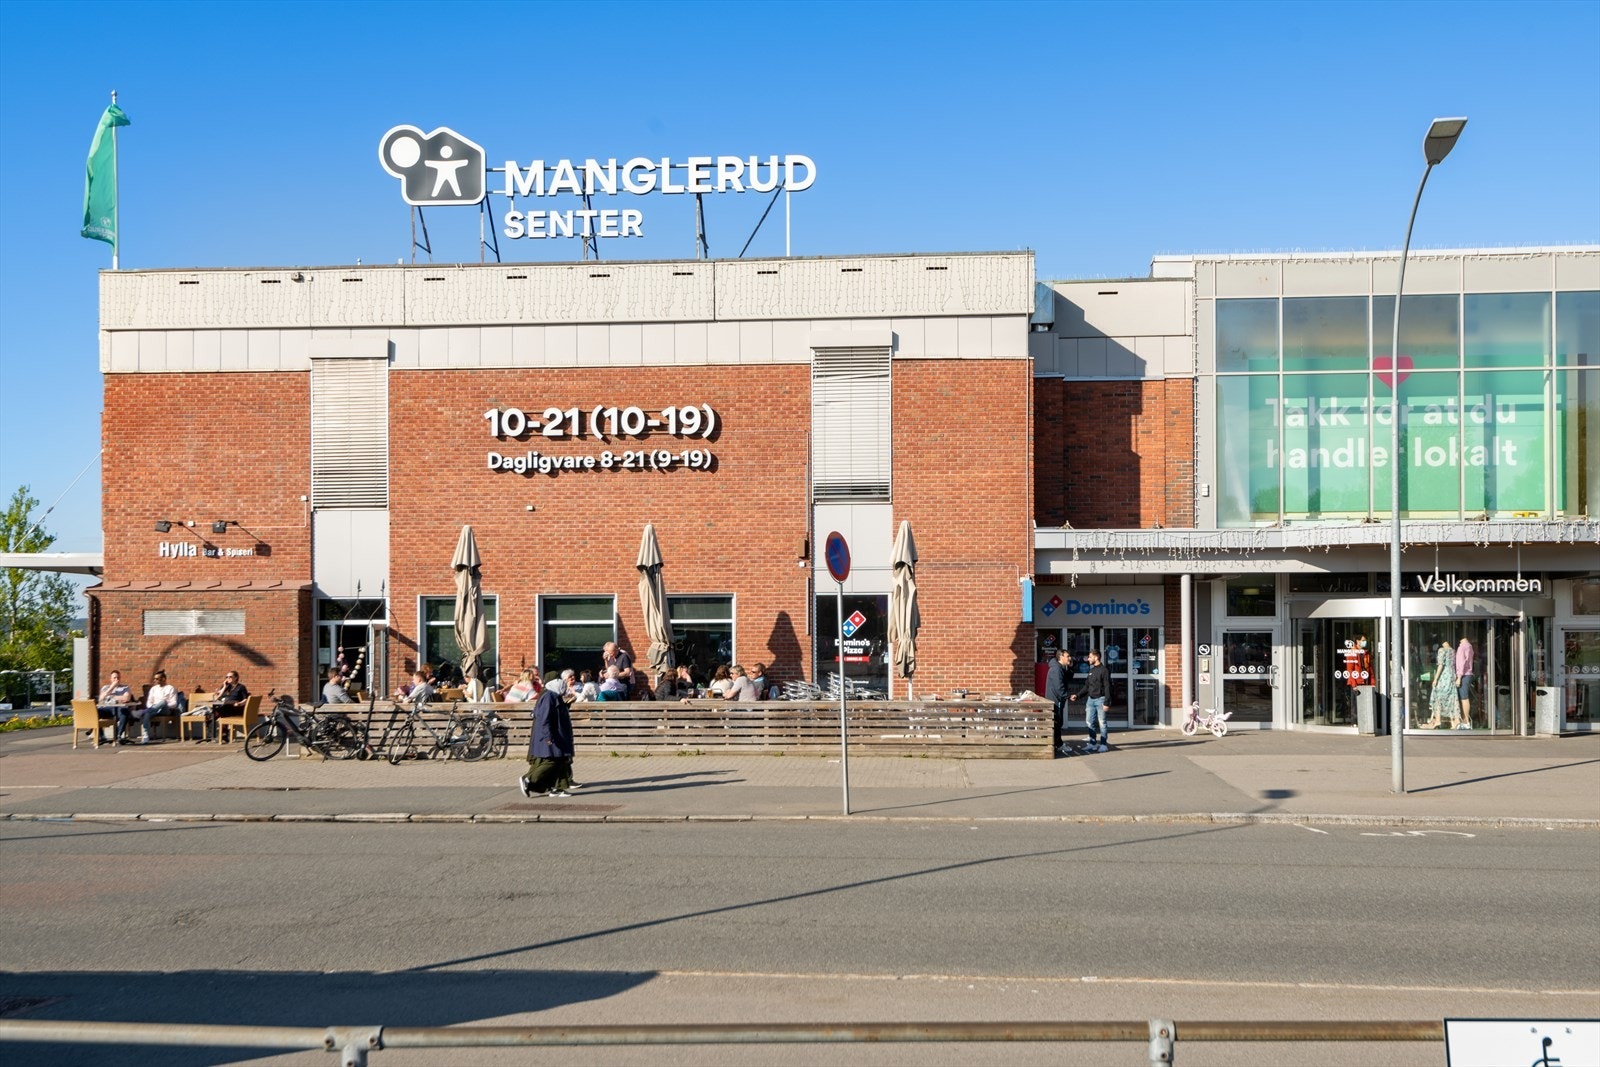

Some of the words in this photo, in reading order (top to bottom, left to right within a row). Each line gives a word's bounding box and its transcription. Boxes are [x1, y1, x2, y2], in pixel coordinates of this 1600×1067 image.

[504, 154, 817, 197] MANGLERUD
[503, 209, 643, 239] SENTER
[483, 407, 580, 437] 10-21
[590, 403, 715, 439] (10-19)
[1265, 396, 1350, 427] Takk
[1423, 397, 1459, 425] at
[1469, 393, 1516, 425] du
[487, 451, 596, 474] Dagligvare
[600, 450, 644, 468] 8-21
[649, 448, 712, 470] (9-19)
[1266, 437, 1405, 469] handle
[1414, 436, 1518, 468] lokalt
[159, 541, 197, 559] Hylla
[203, 548, 216, 556] Bar
[1417, 574, 1542, 593] Velkommen
[1066, 598, 1150, 615] Domino's
[834, 638, 870, 647] Dmino's
